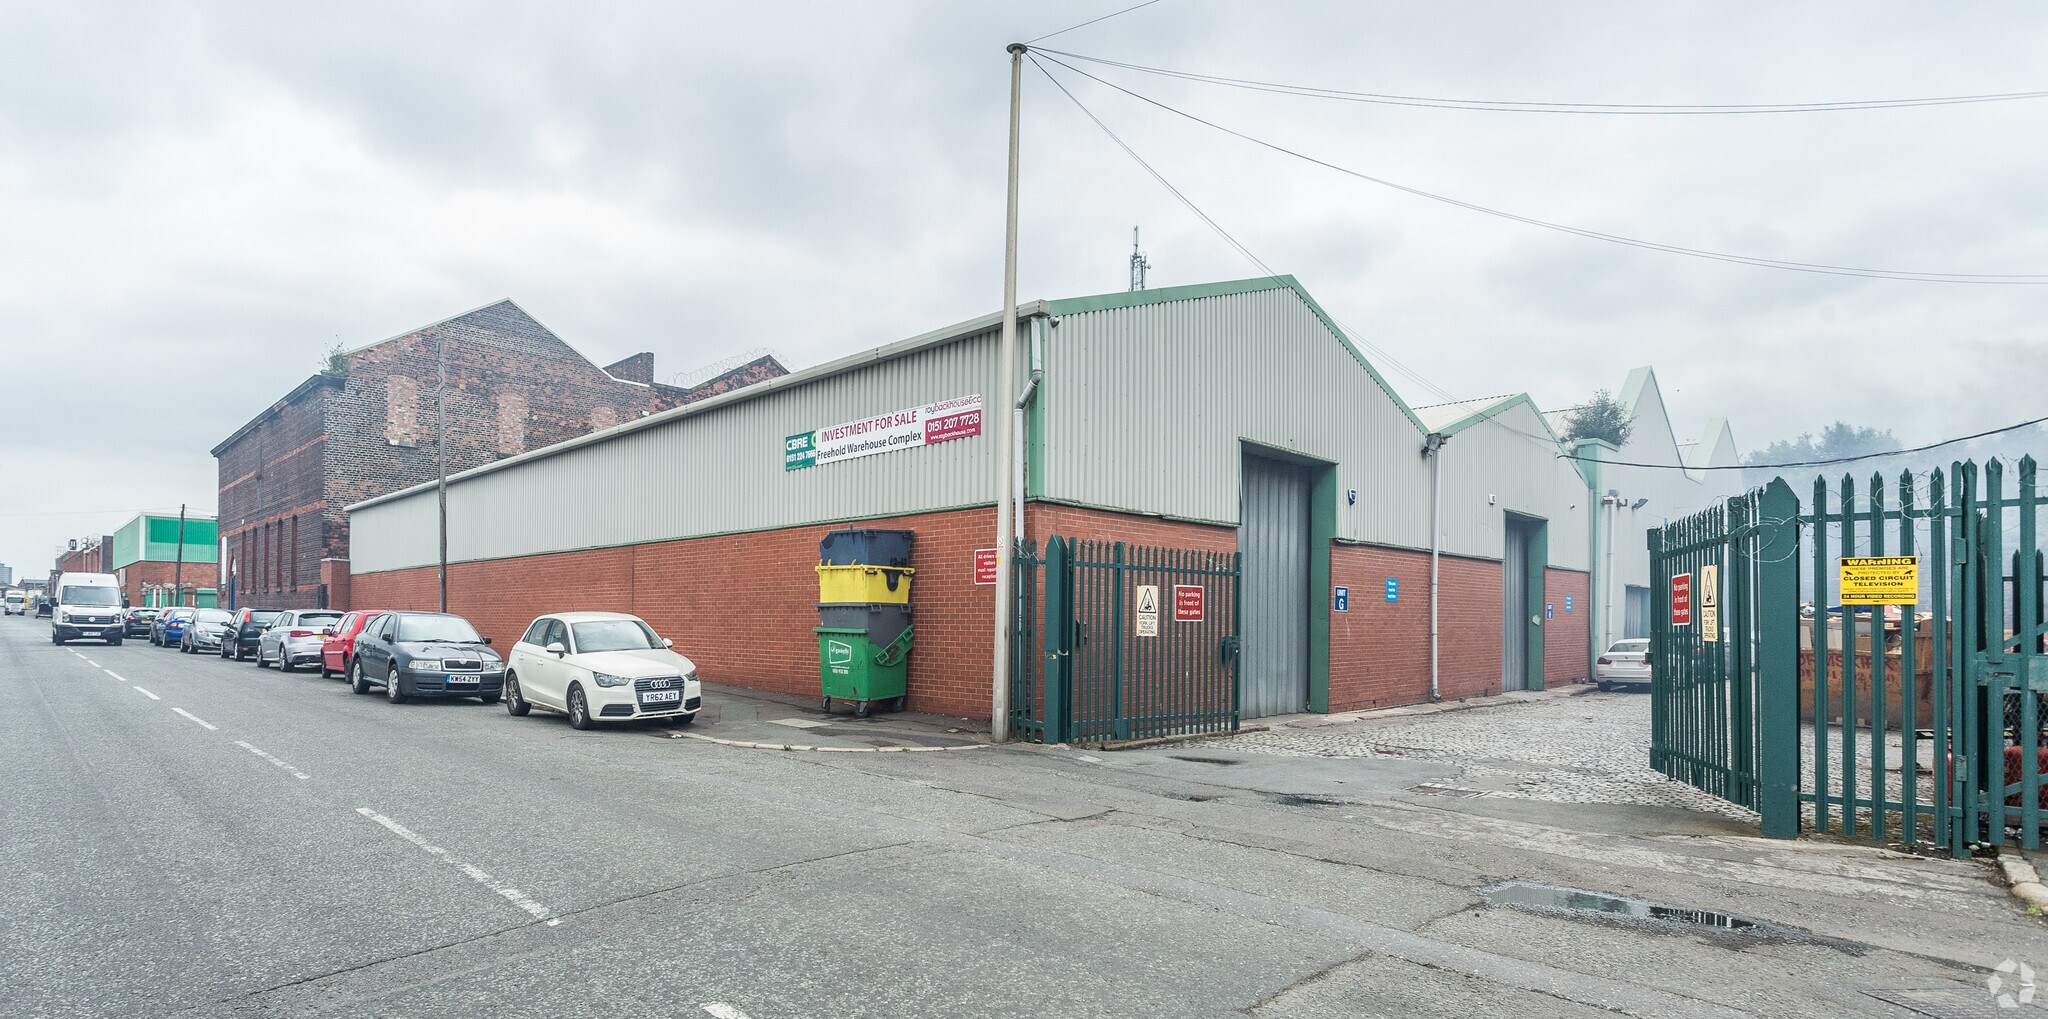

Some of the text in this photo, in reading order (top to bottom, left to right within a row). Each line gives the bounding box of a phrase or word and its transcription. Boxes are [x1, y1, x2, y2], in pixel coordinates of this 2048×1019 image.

[821, 410, 917, 442] INVESTMENT FOR SALE
[927, 412, 979, 432] 0151 207 7728
[786, 436, 808, 451] CBRE
[817, 431, 922, 460] Freehold Warehouse Complex
[786, 453, 797, 462] 0151
[1846, 558, 1912, 566] WARNING
[1185, 591, 1201, 599] parking
[1338, 598, 1344, 610] G
[1703, 610, 1716, 618] CAUTION
[645, 692, 677, 702] YR62 AEY
